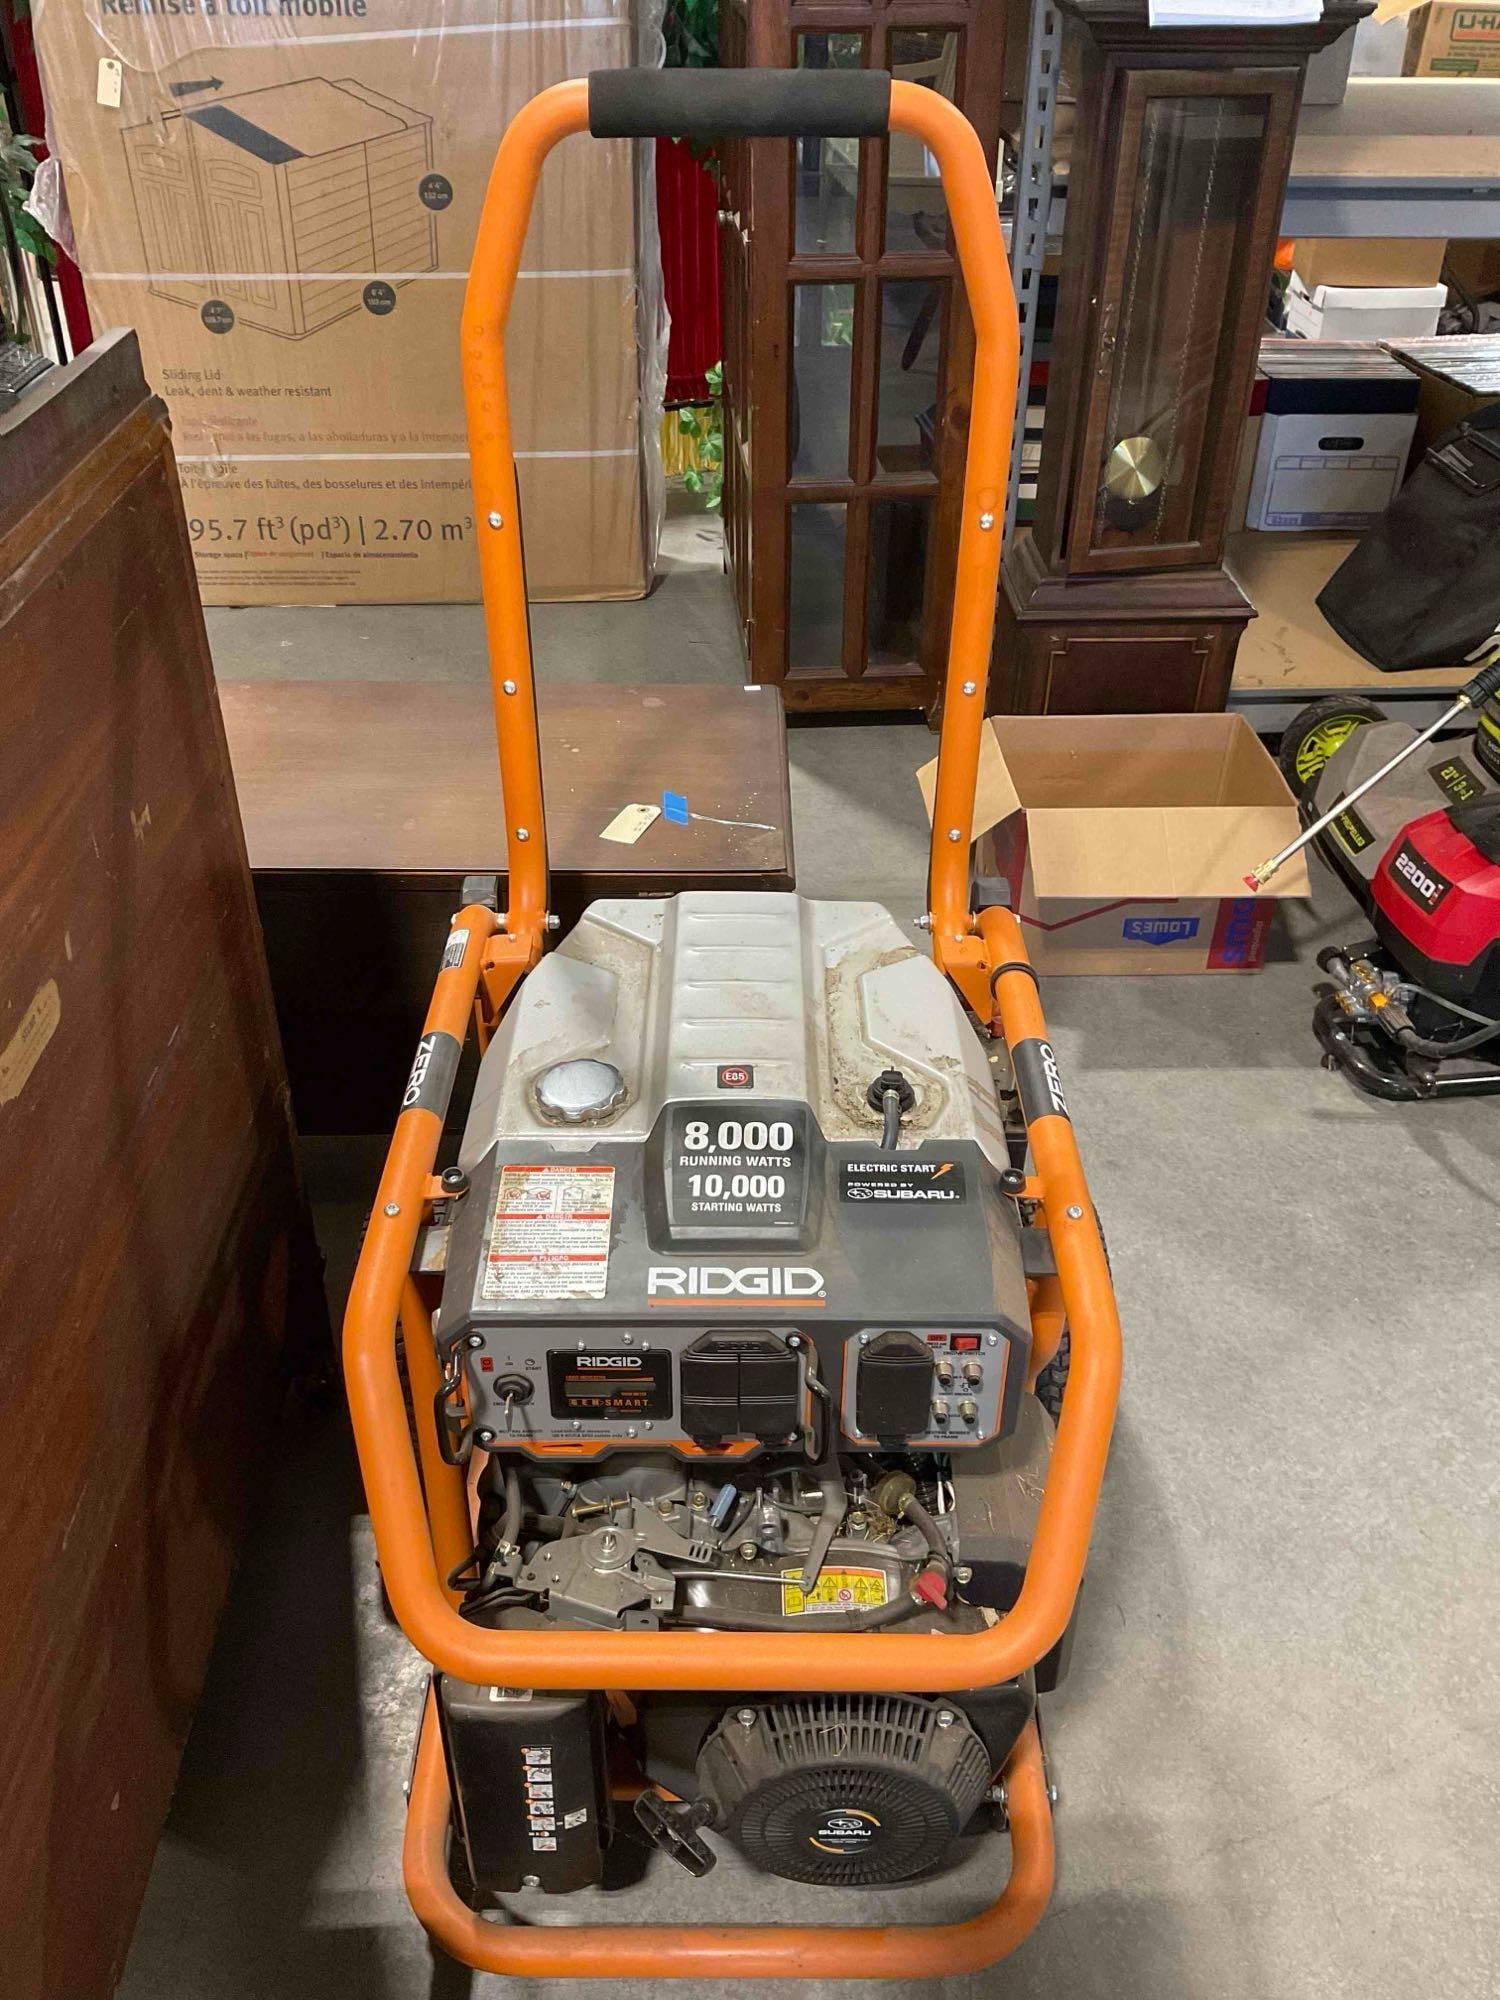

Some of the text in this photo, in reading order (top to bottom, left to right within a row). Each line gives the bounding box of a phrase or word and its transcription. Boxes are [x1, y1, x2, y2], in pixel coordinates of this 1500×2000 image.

[279, 0, 367, 17] mobile
[204, 369, 221, 380] Lid
[165, 386, 332, 397] Leak, dent & weather resistant
[308, 431, 323, 442] las
[243, 479, 263, 489] des
[265, 479, 299, 490] fuites,
[302, 479, 322, 489] des
[324, 479, 383, 489] bosselures
[385, 480, 397, 489] et
[398, 479, 418, 489] des
[189, 518, 247, 541] 95.7
[374, 519, 433, 541] 2.70
[1395, 852, 1436, 898] 2200
[401, 1034, 437, 1106] ZERO
[1040, 1042, 1070, 1118] ZERO
[684, 1121, 794, 1153] 8,000
[679, 1155, 792, 1168] RUNNING WATTS
[847, 1163, 936, 1173] ELECTRIC START
[688, 1174, 786, 1200] 10,000
[873, 1189, 955, 1199] SUBARU
[691, 1201, 782, 1213] STARTING WATTS
[576, 1356, 642, 1367] RIDGID
[818, 1829, 872, 1837] SUBARU
